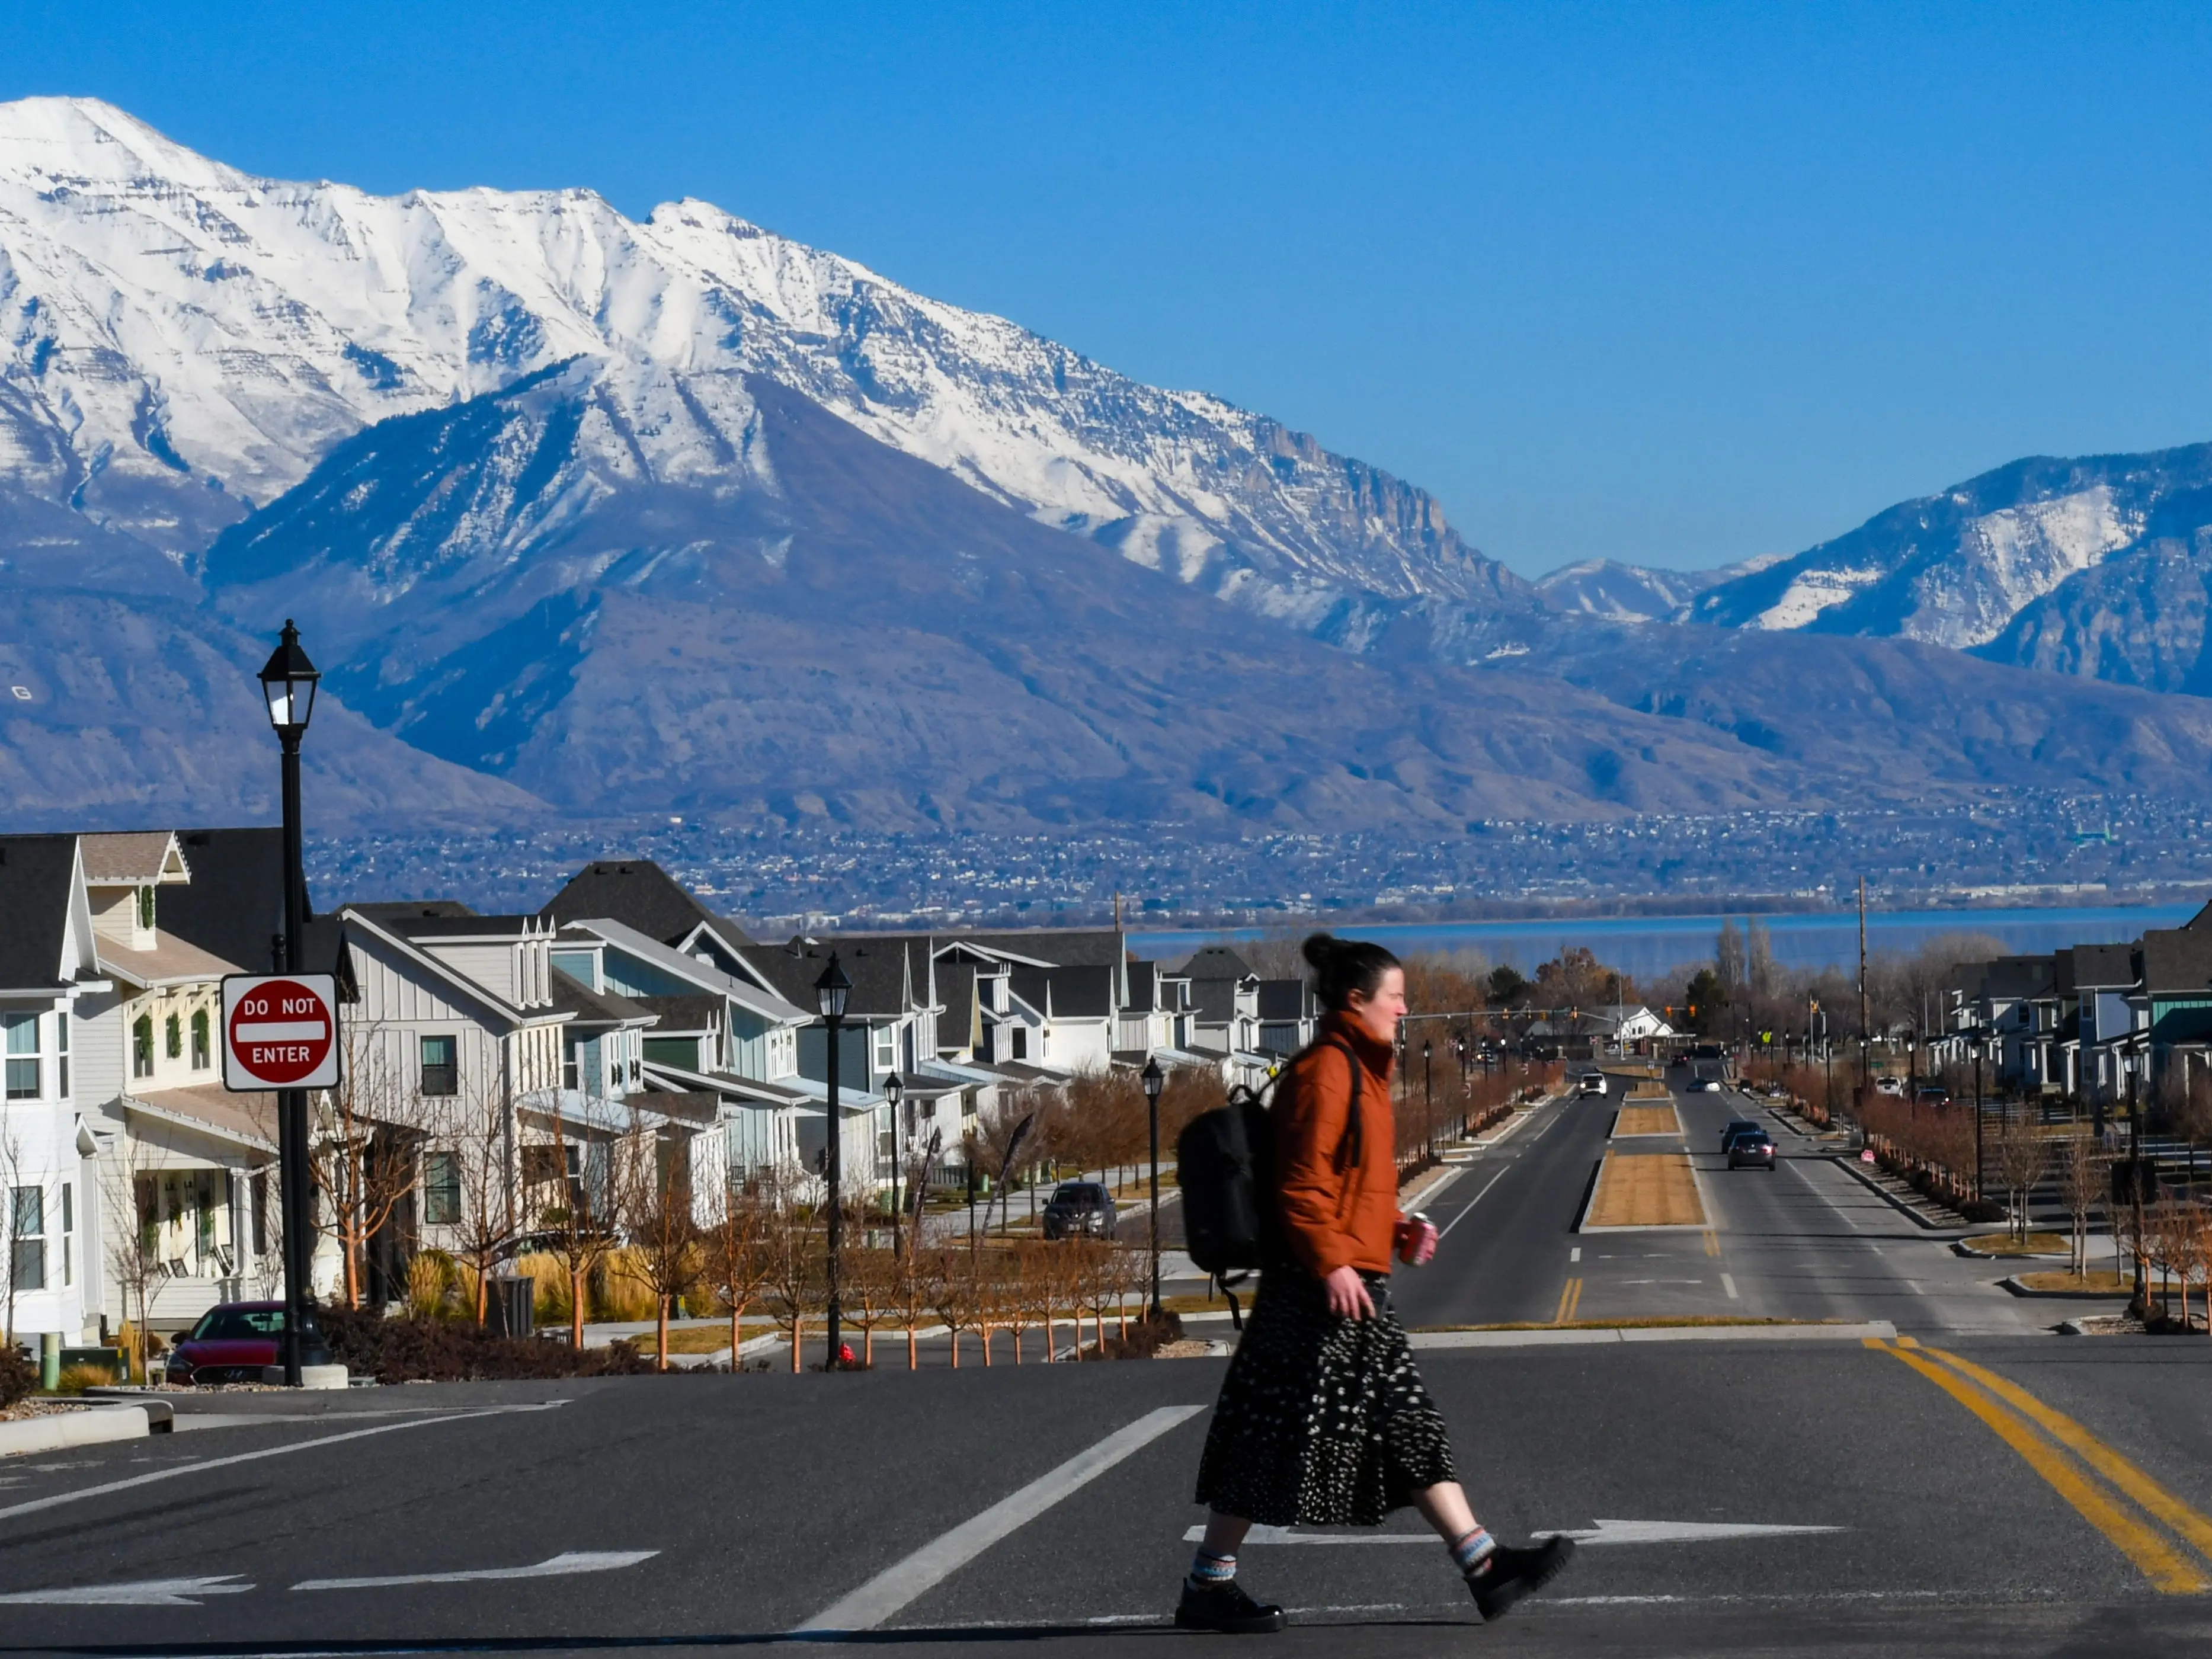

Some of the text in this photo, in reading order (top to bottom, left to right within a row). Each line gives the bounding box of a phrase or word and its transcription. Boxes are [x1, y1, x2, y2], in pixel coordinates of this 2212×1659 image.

[244, 998, 316, 1016] DO NOT
[252, 1046, 310, 1064] ENTER
